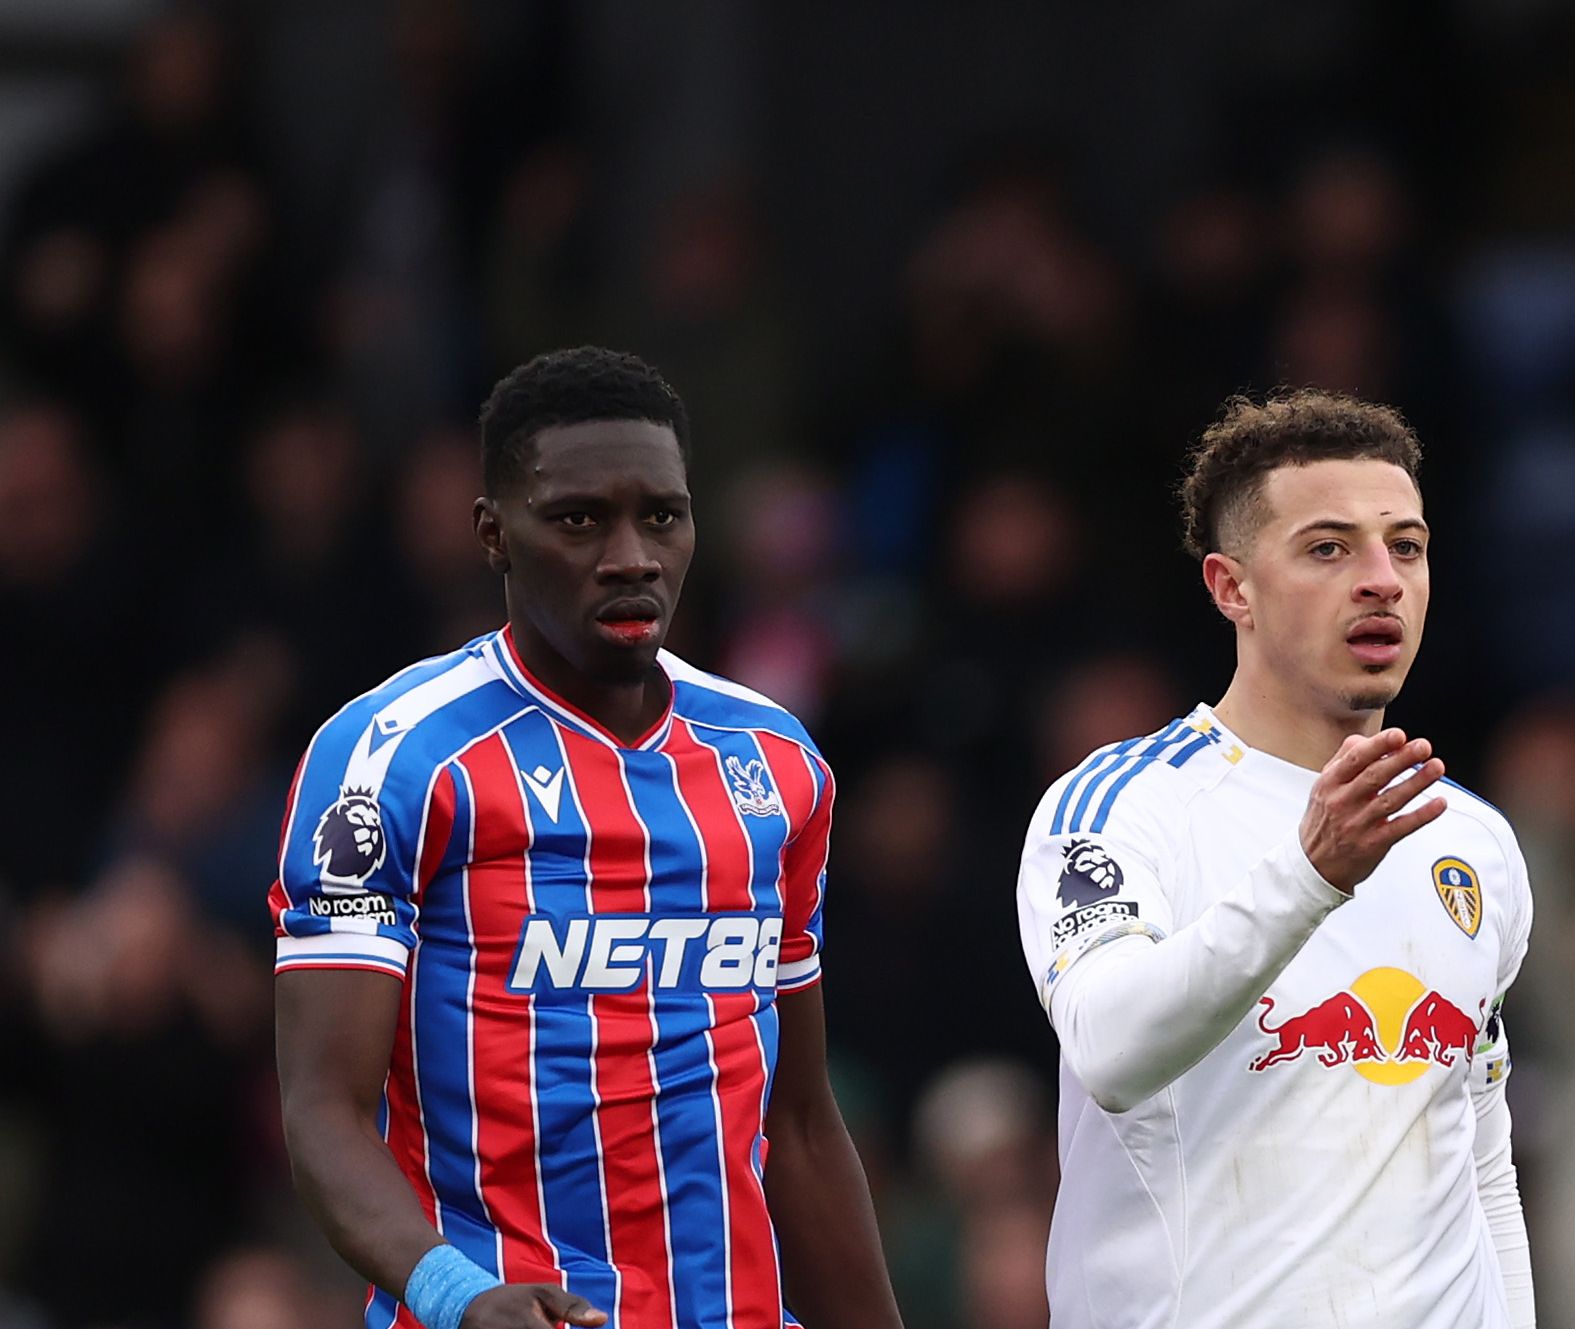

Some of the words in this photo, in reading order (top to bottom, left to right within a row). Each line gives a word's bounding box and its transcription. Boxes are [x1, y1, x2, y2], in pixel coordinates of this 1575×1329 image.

[309, 897, 331, 917] No
[333, 895, 387, 914] room
[1051, 917, 1075, 938] No
[1075, 903, 1130, 925] room
[510, 917, 783, 989] NET88
